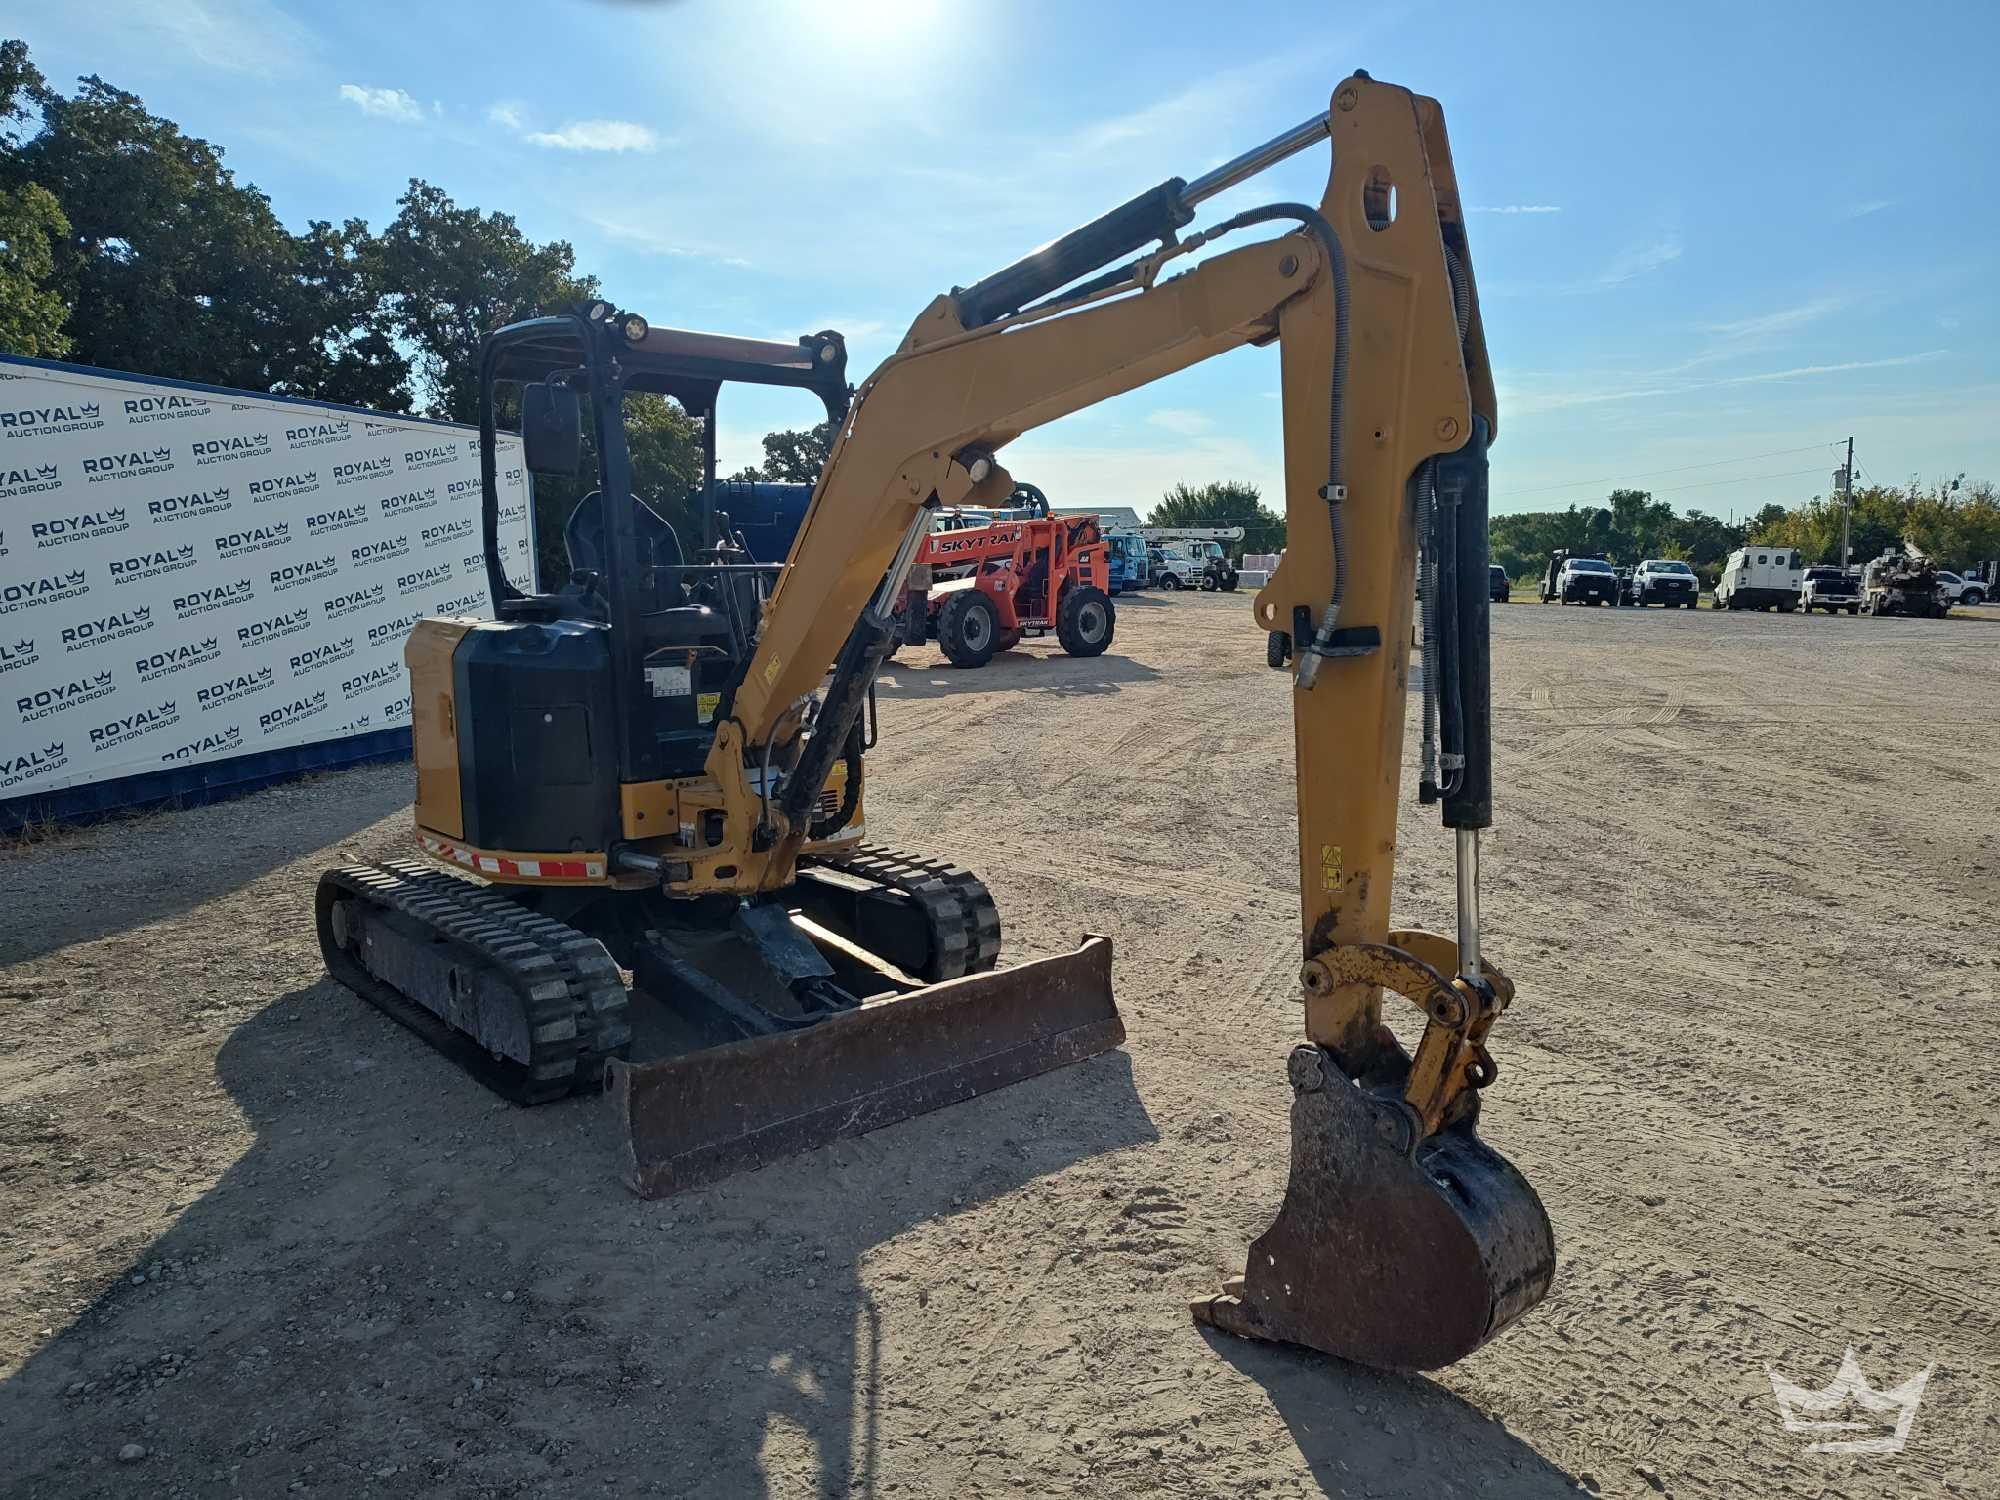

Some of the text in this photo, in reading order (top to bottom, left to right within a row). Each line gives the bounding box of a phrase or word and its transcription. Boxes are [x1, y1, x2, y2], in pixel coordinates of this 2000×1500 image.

[124, 396, 192, 414] ROYAL
[129, 408, 210, 424] AUCTION GROUP
[0, 406, 81, 428] ROYAL
[7, 420, 104, 438] AUCTION GROUP
[286, 424, 337, 441] ROYAL
[192, 436, 254, 456] ROYAL
[290, 437, 326, 450] AUCTION
[405, 446, 446, 463] ROYAL
[82, 451, 154, 474] ROYAL
[196, 448, 272, 465] AUCTION GROUP
[88, 464, 174, 484] AUCTION GROUP
[333, 460, 380, 478] ROYAL
[369, 470, 394, 480] GROUP
[20, 480, 62, 494] GROUP
[248, 475, 306, 494] ROYAL
[253, 484, 320, 504] AUCTION GROUP
[148, 492, 214, 514] ROYAL
[381, 492, 424, 510] ROYAL
[384, 504, 414, 518] AUCTION
[153, 502, 232, 524] AUCTION GROUP
[306, 508, 354, 528] ROYAL
[32, 512, 108, 538] ROYAL
[38, 523, 130, 548] AUCTION GROUP
[310, 517, 368, 536] AUCTION GROUP
[422, 521, 462, 540] ROYAL
[216, 527, 275, 550] ROYAL
[220, 536, 292, 560] AUCTION GROUP
[424, 534, 452, 548] AUCTION
[352, 540, 396, 560] ROYAL
[354, 548, 410, 568] AUCTION GROUP
[464, 554, 486, 566] ROY
[109, 550, 178, 576] ROYAL
[114, 560, 198, 585] AUCTION GROUP
[270, 561, 324, 583] ROYAL
[274, 568, 338, 592] AUCTION GROUP
[397, 568, 440, 588] ROYAL
[400, 574, 453, 596] AUCTION GROUP
[0, 576, 67, 604] OYAL
[0, 586, 90, 614] UCTION GROUP
[173, 585, 236, 610] ROYAL
[324, 590, 372, 612] ROYAL
[178, 593, 254, 620] AUCTION GROUP
[328, 603, 360, 620] AUCTION
[436, 594, 478, 614] ROYAL
[62, 612, 134, 644] ROYAL
[66, 621, 154, 654] AUCTION GROUP
[237, 614, 294, 640] ROYAL
[242, 621, 311, 648] AUCTION GROUP
[368, 616, 413, 640] ROYAL
[371, 631, 401, 648] AUCTION
[136, 644, 202, 674] ROYAL
[141, 650, 222, 682] AUCTION GROUP
[290, 643, 342, 669] ROYAL
[294, 659, 328, 678] AUCTION
[342, 667, 389, 692] ROYAL
[17, 680, 95, 713] ROYAL
[196, 674, 259, 702] ROYAL
[202, 680, 274, 712] AUCTION GROUP
[345, 682, 377, 700] AUCTION
[22, 686, 116, 723] AUCTION GROUP
[260, 698, 314, 728] ROYAL
[384, 696, 412, 716] ROY
[90, 709, 160, 742] ROYAL
[264, 703, 328, 736] AUCTION GROUP
[95, 715, 180, 752] AUCTION GROUP
[0, 752, 45, 776] YAL
[24, 757, 68, 778] GROUP
